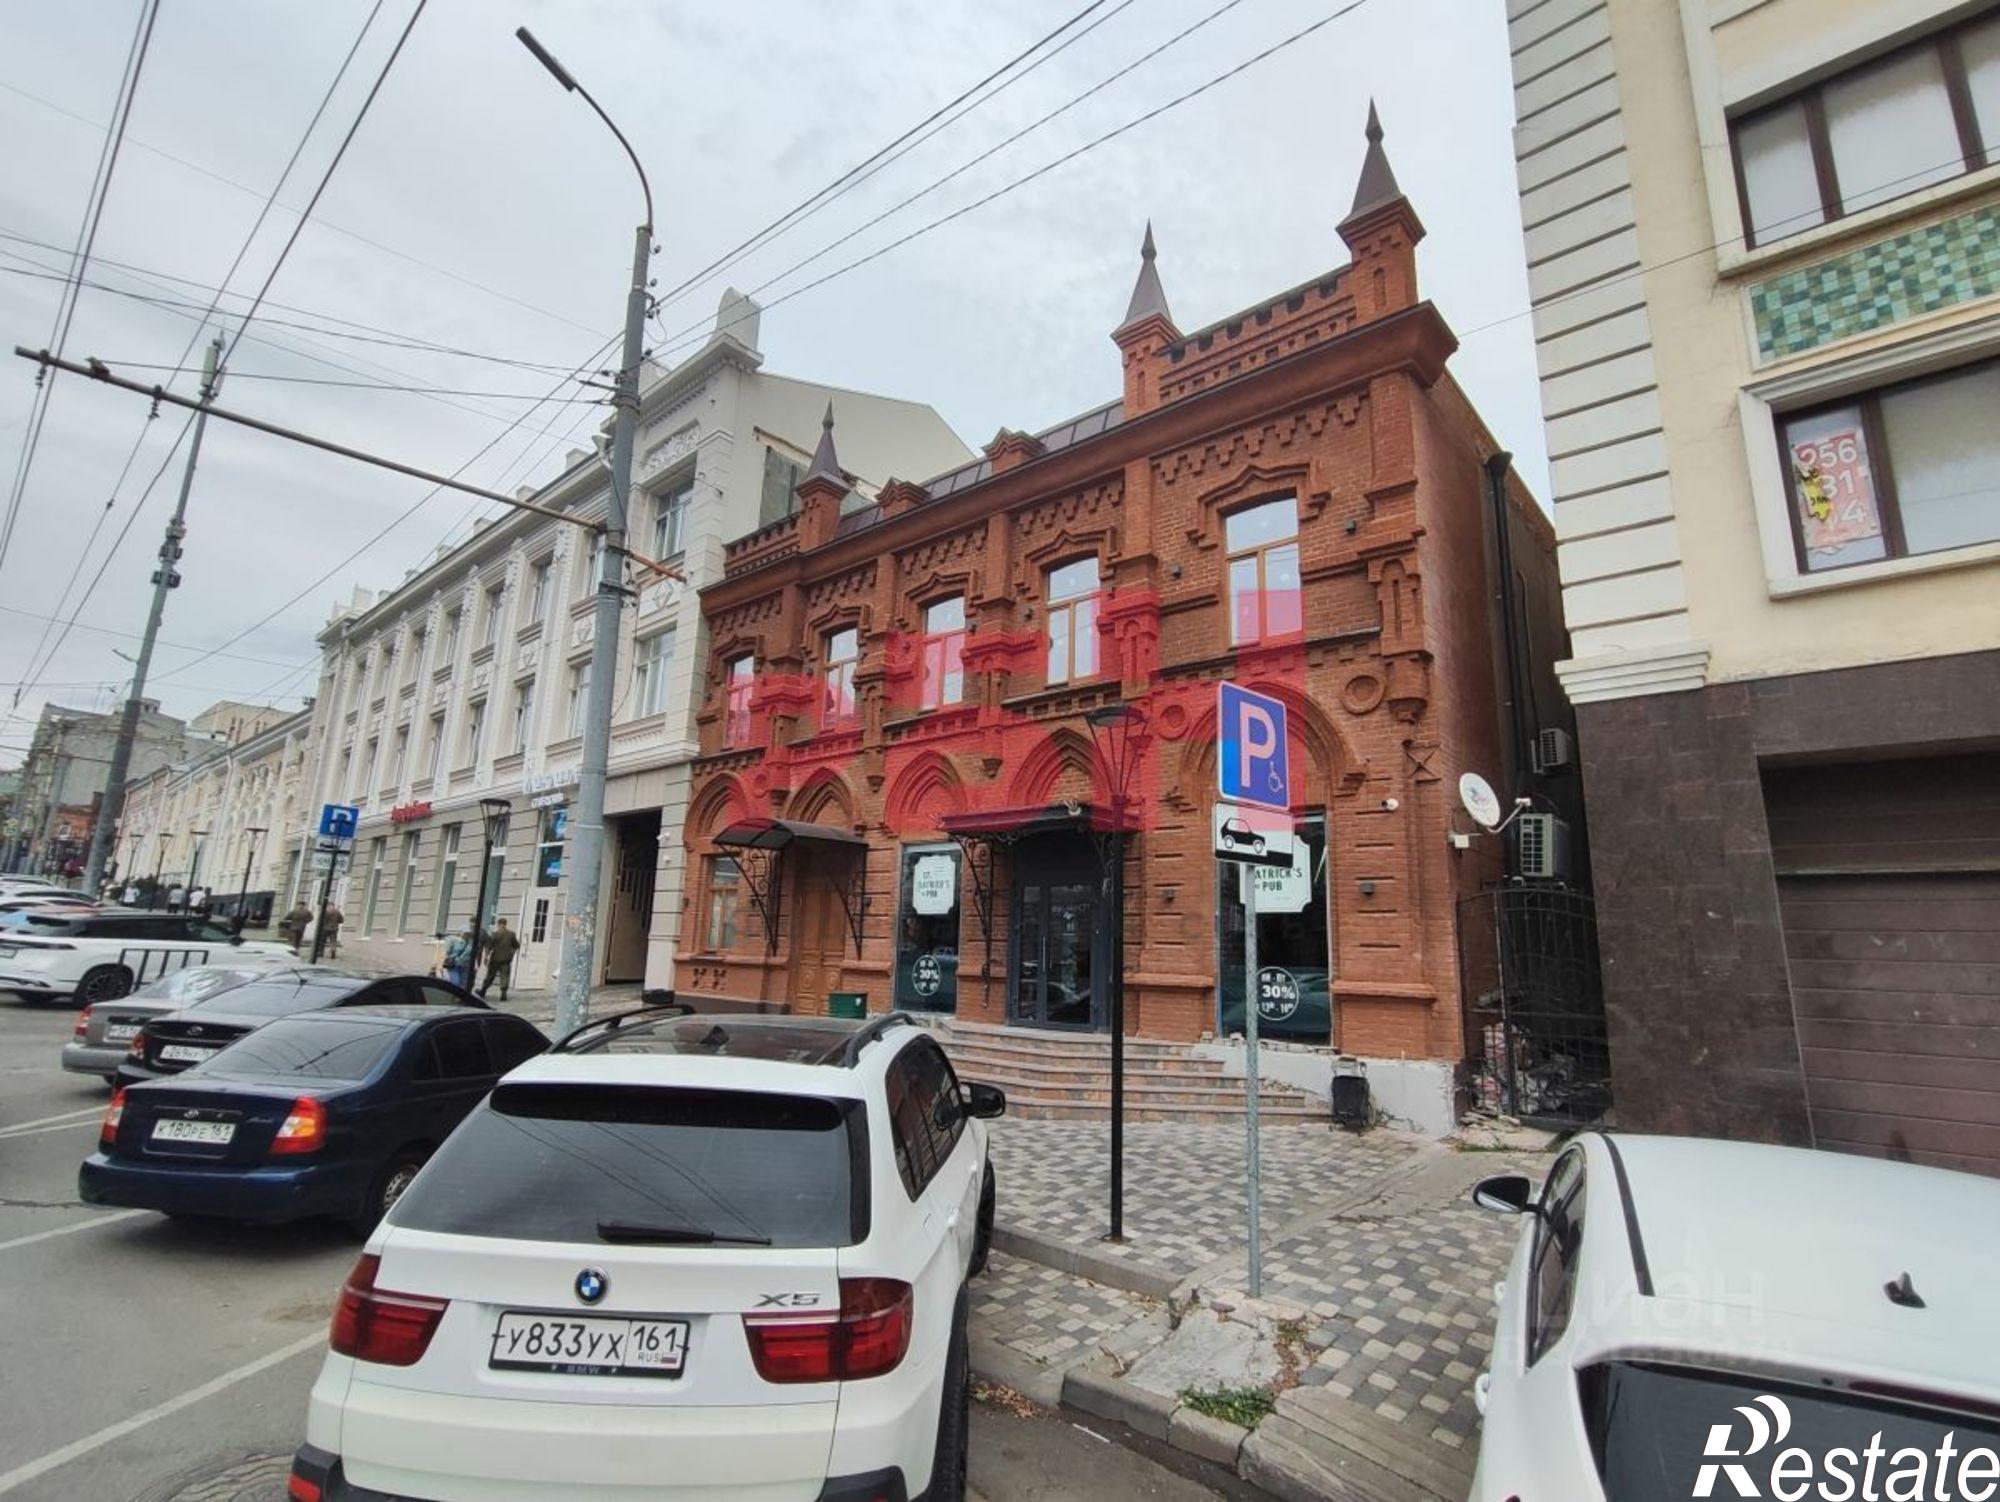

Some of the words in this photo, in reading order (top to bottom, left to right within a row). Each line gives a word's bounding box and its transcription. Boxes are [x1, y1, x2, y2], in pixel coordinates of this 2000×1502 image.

[1798, 439, 1857, 472] 256
[1240, 700, 1277, 789] P
[1254, 867, 1303, 880] ATRICK'S
[1262, 880, 1283, 892] PUB
[754, 1292, 821, 1307] X5
[633, 1325, 677, 1352] 161
[638, 1352, 660, 1363] RUS
